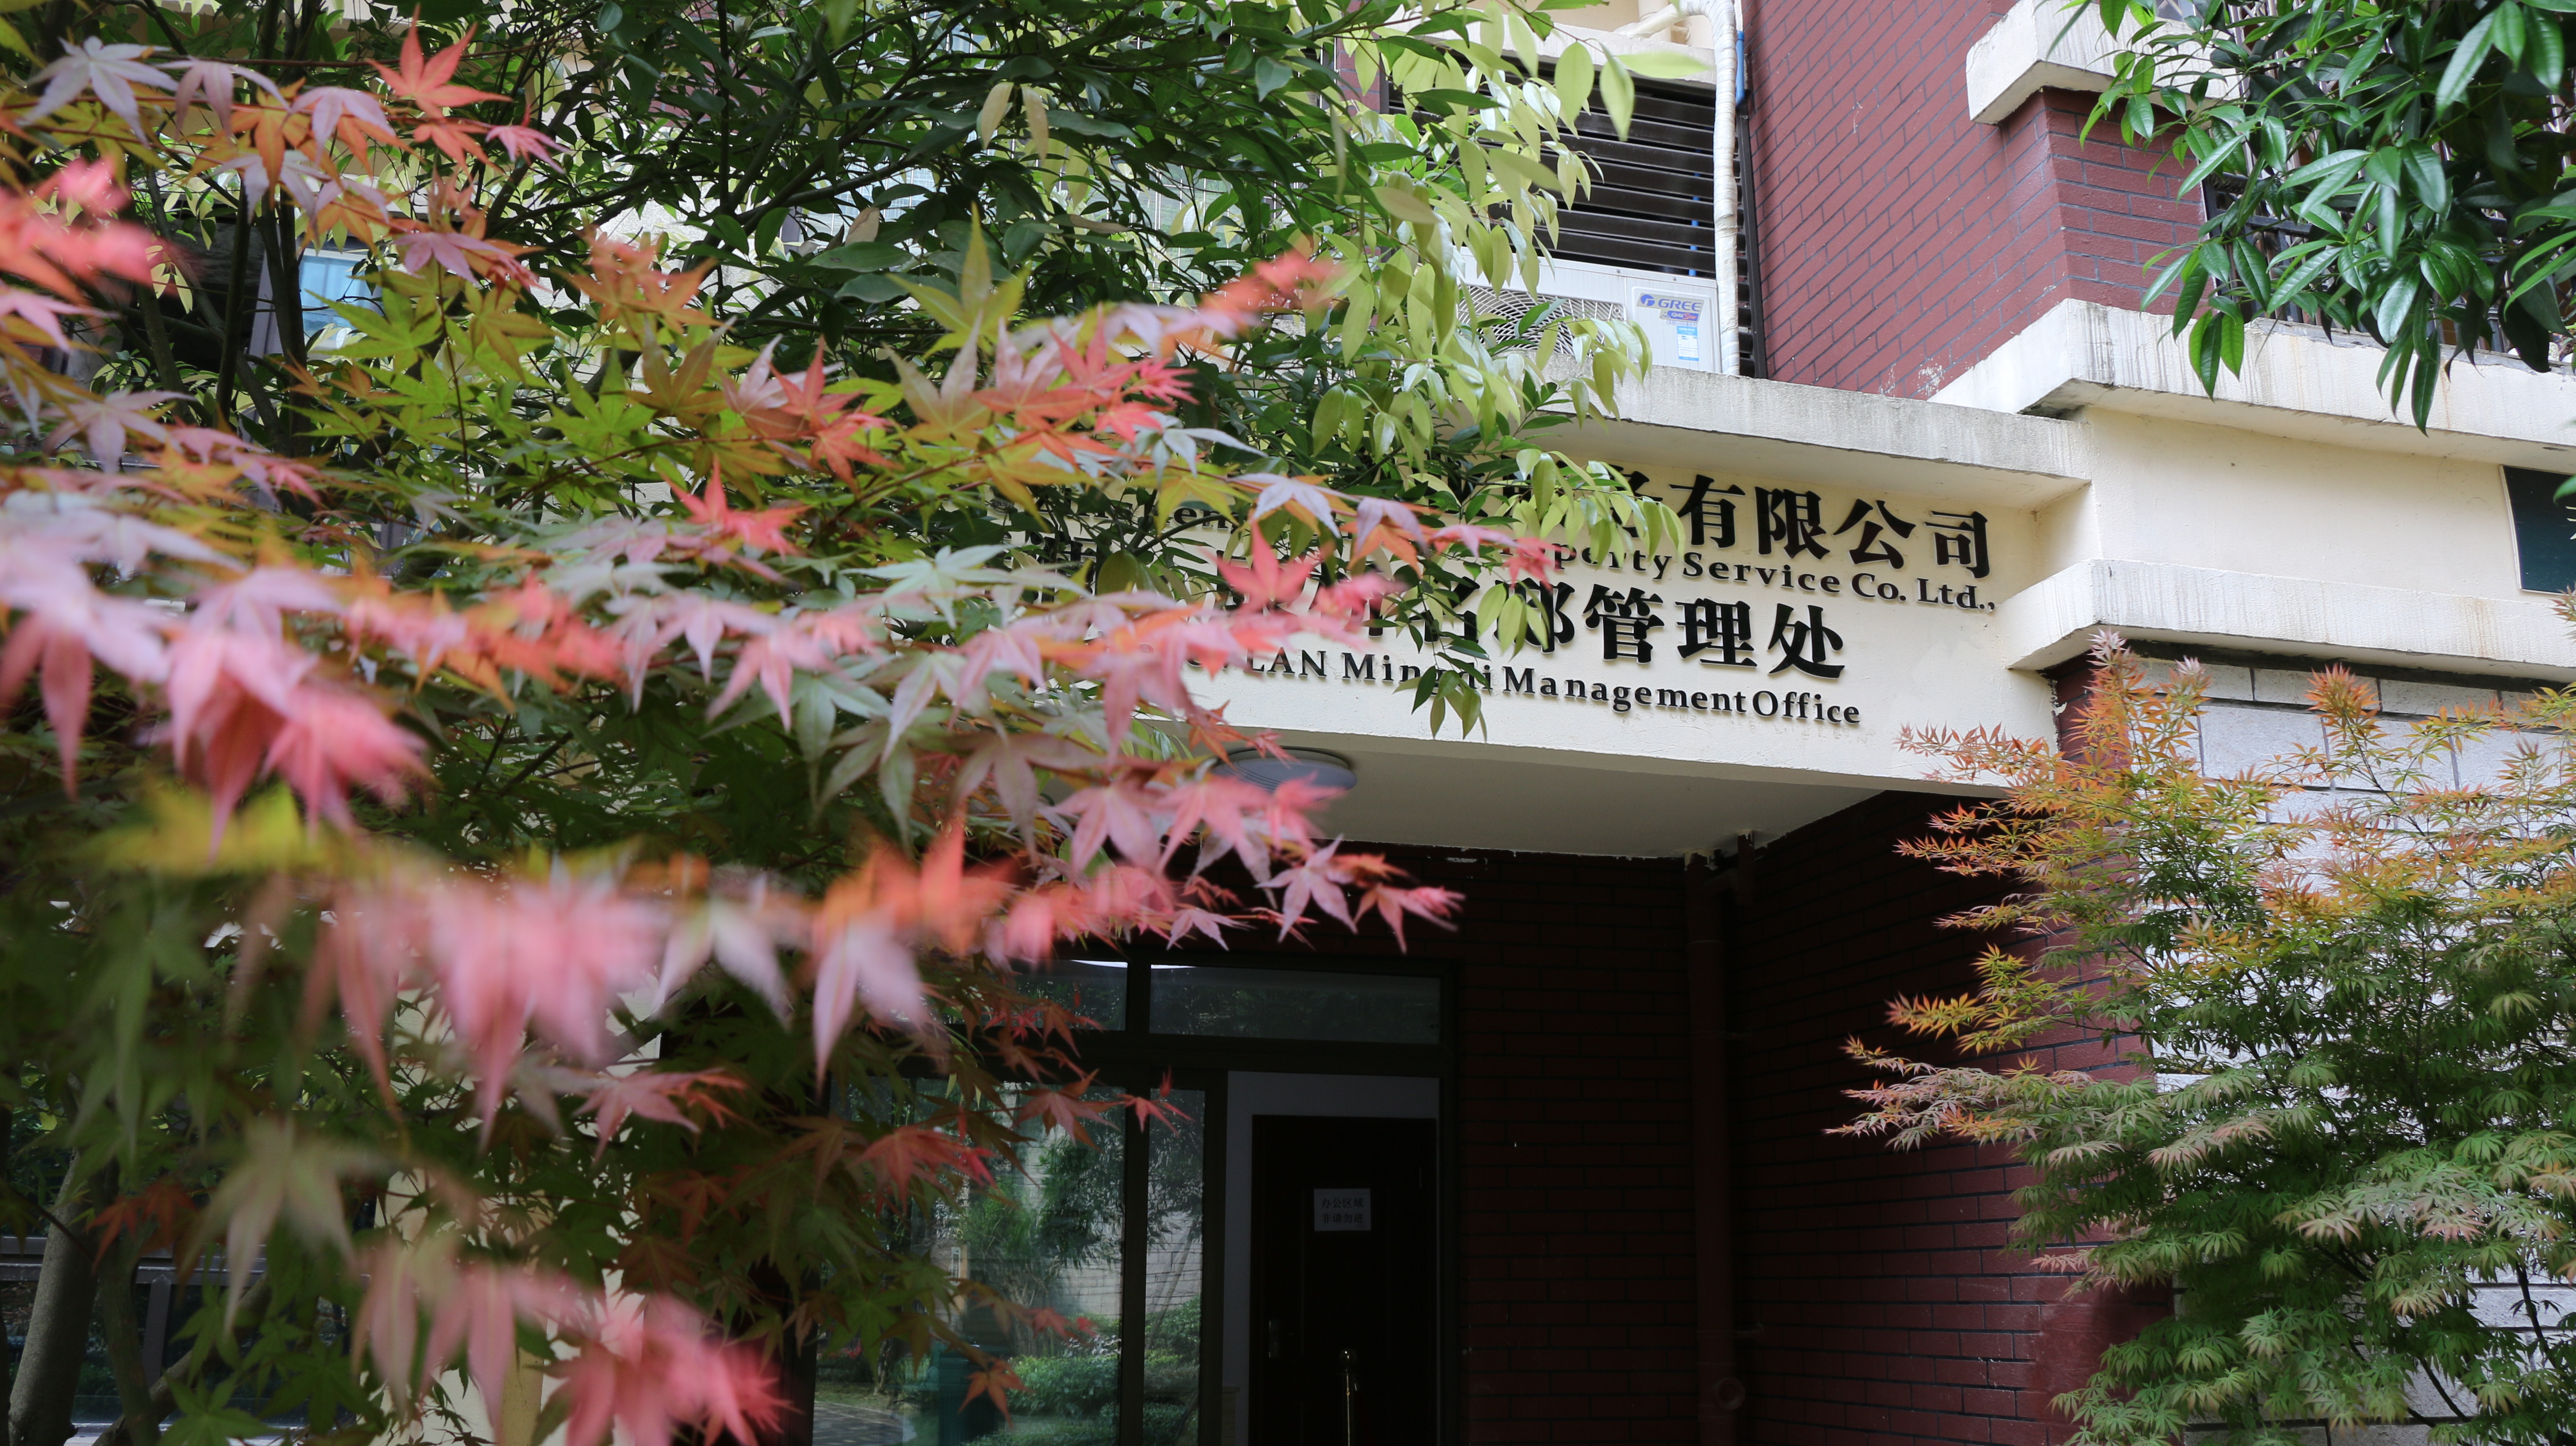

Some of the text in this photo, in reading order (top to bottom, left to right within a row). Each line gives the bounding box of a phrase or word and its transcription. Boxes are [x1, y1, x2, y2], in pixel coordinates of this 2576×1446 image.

[1658, 298, 1702, 312] GREE
[1682, 551, 1840, 593] Service
[1851, 572, 1907, 602] Co.
[1321, 1197, 1364, 1208] 办公区域
[1321, 1213, 1364, 1224] 非请勿进
